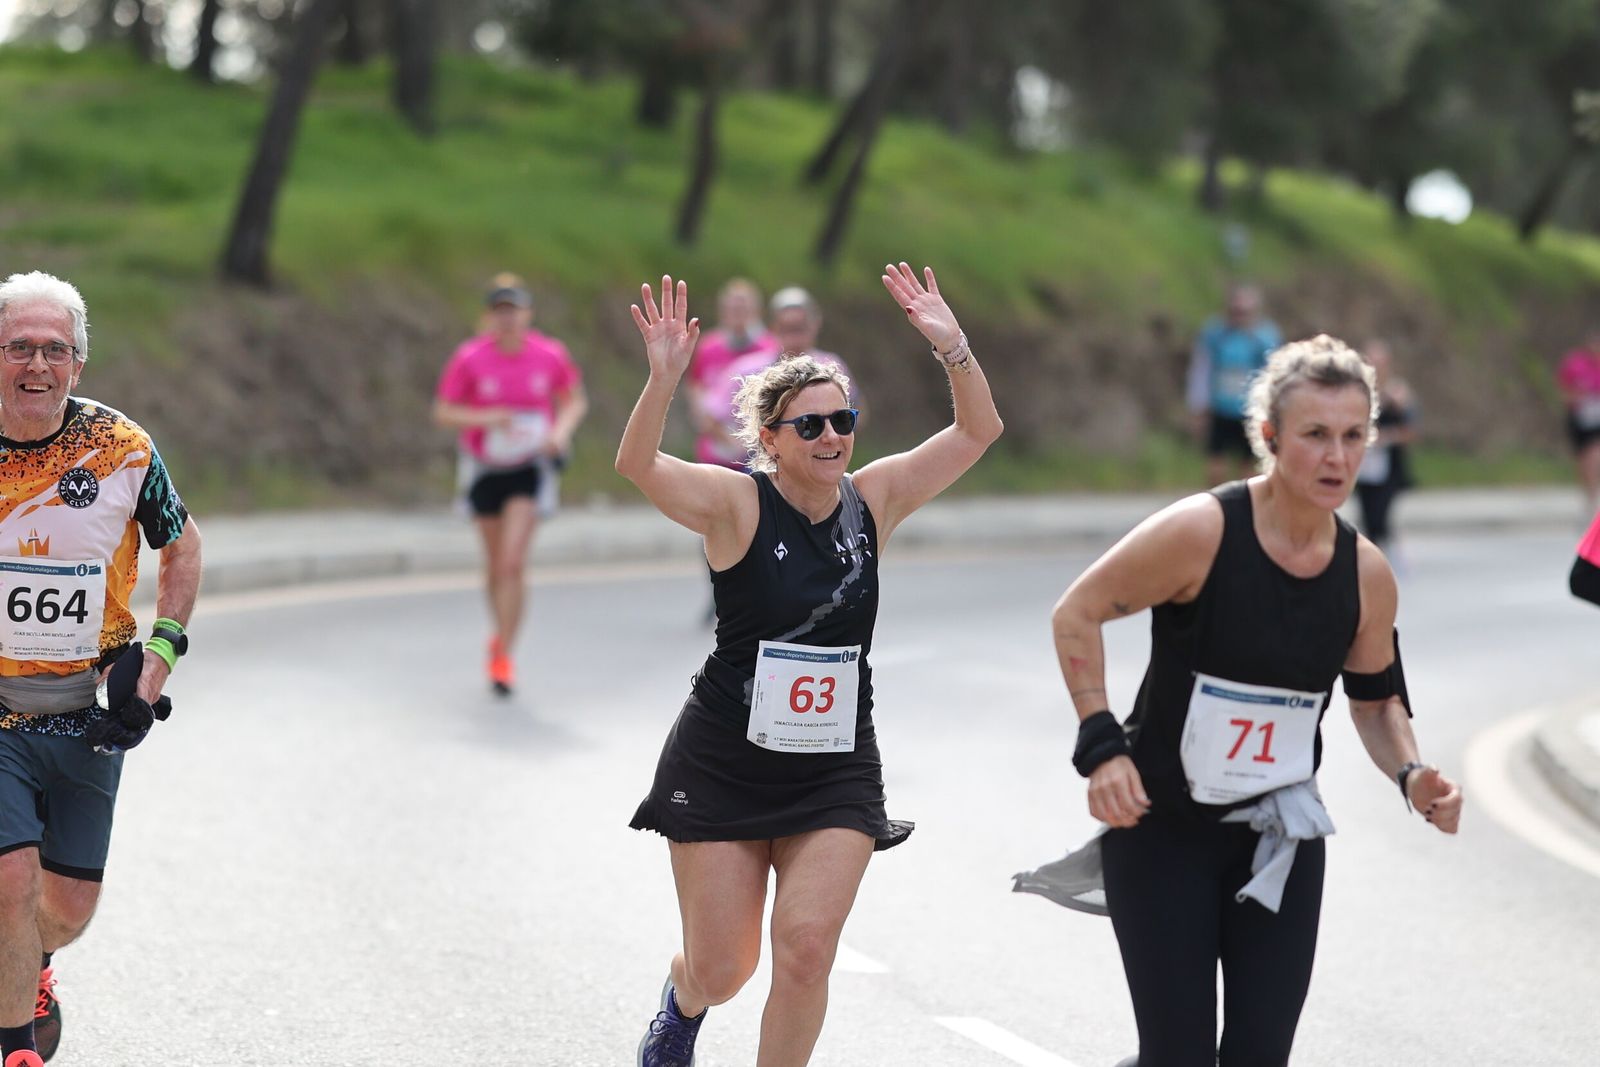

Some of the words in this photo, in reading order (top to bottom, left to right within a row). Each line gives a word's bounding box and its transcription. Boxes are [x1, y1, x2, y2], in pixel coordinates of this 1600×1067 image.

[61, 470, 97, 495] TRAZACAMINOS
[69, 499, 91, 507] CLUB
[7, 586, 89, 624] 664
[789, 675, 836, 714] 63
[1226, 718, 1276, 763] 71
